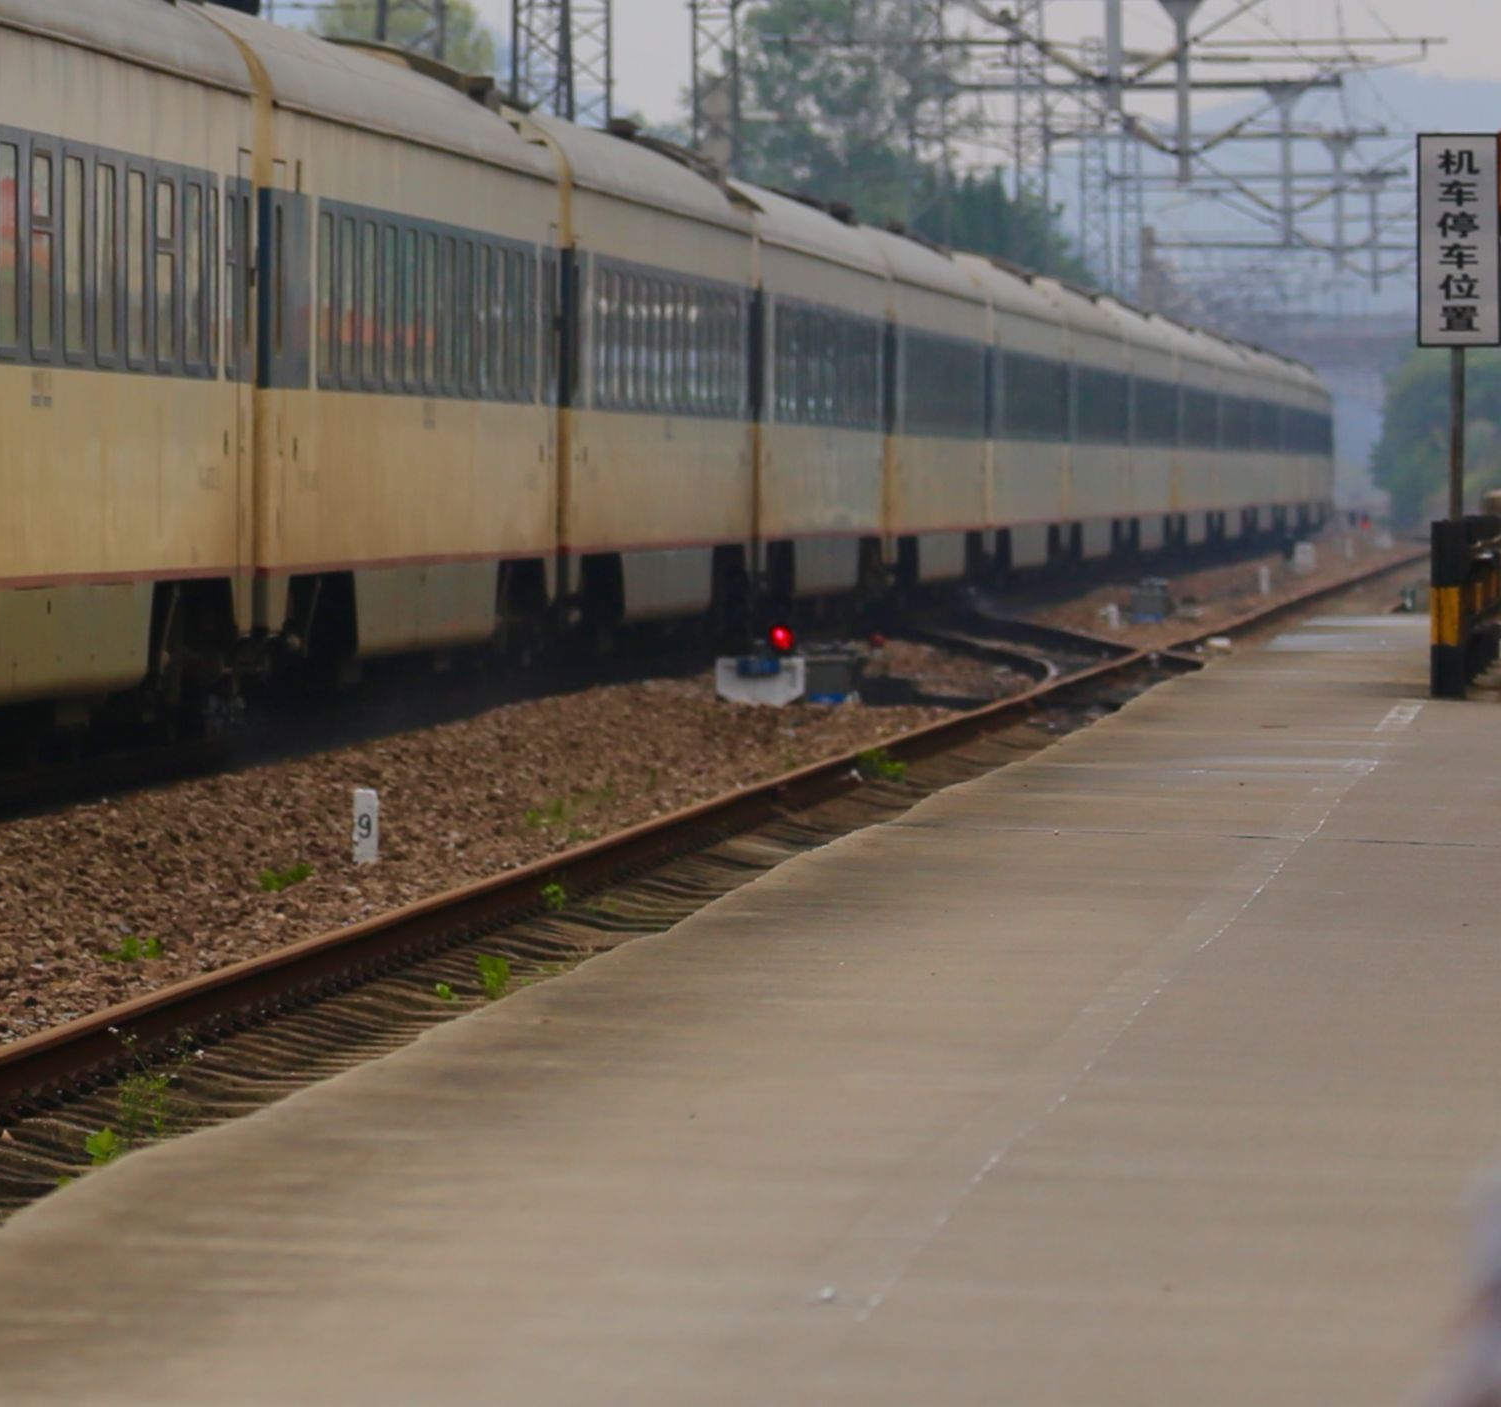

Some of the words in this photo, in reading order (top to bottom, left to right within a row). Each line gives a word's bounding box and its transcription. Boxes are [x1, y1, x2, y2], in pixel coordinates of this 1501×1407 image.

[1437, 149, 1481, 332] 机车停车位置
[358, 813, 372, 839] 9
